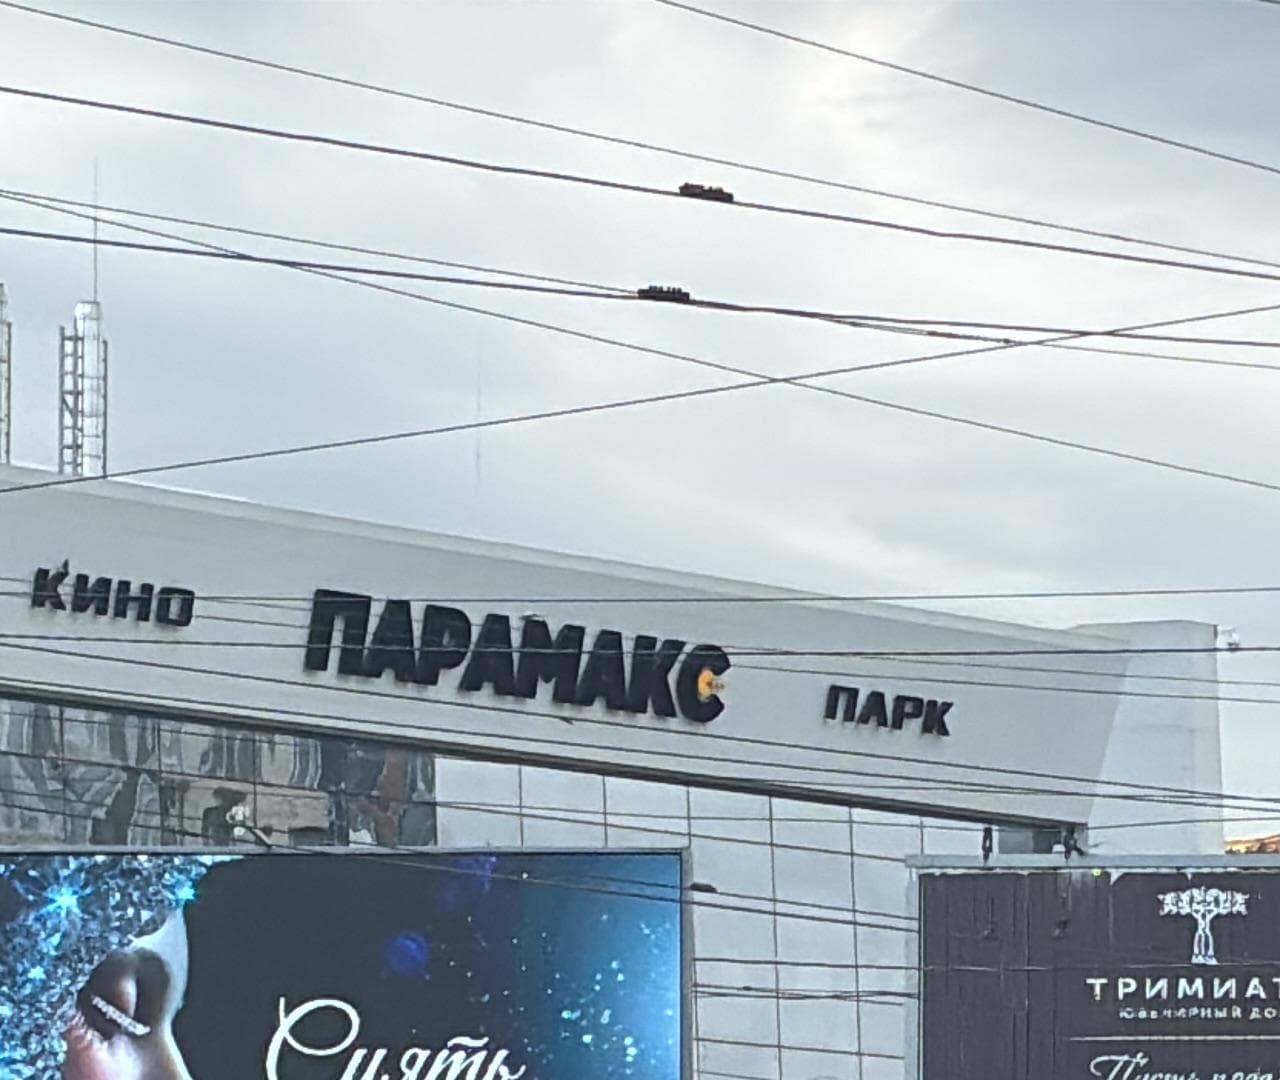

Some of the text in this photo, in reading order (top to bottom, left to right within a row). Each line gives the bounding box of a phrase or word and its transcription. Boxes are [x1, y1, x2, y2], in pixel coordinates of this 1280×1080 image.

[32, 567, 954, 737] КИНО ПАРАМАКС ПАРК
